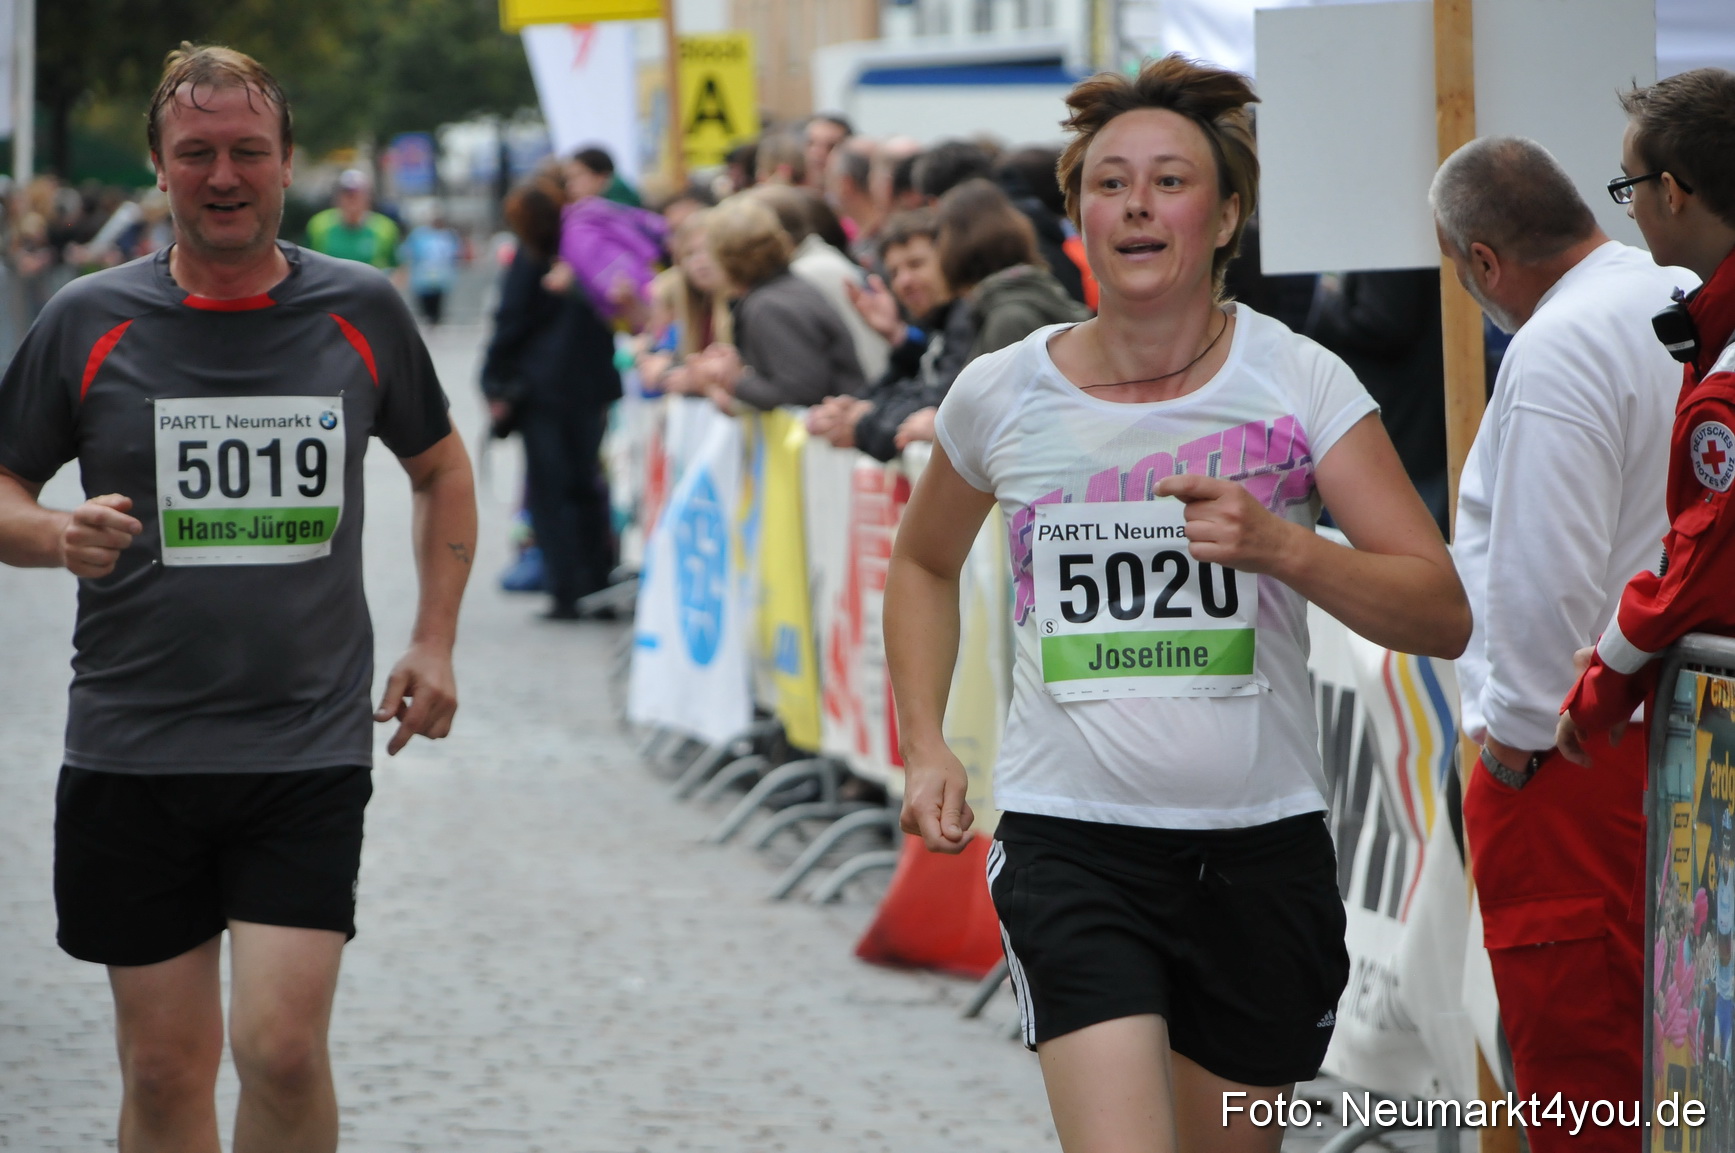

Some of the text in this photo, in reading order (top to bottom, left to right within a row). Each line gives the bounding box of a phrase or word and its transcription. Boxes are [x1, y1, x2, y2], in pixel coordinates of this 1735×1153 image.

[688, 75, 736, 135] A
[160, 413, 312, 430] PARTL Neumarkt
[1693, 426, 1733, 453] DEUTSCHES
[177, 437, 327, 499] 5019
[1695, 460, 1719, 487] ROTES
[178, 515, 325, 544] Hans-Jürgen
[1038, 523, 1108, 541] PARTL
[1059, 549, 1239, 624] 5020
[1046, 621, 1054, 634] S
[1089, 640, 1209, 671] Josefine
